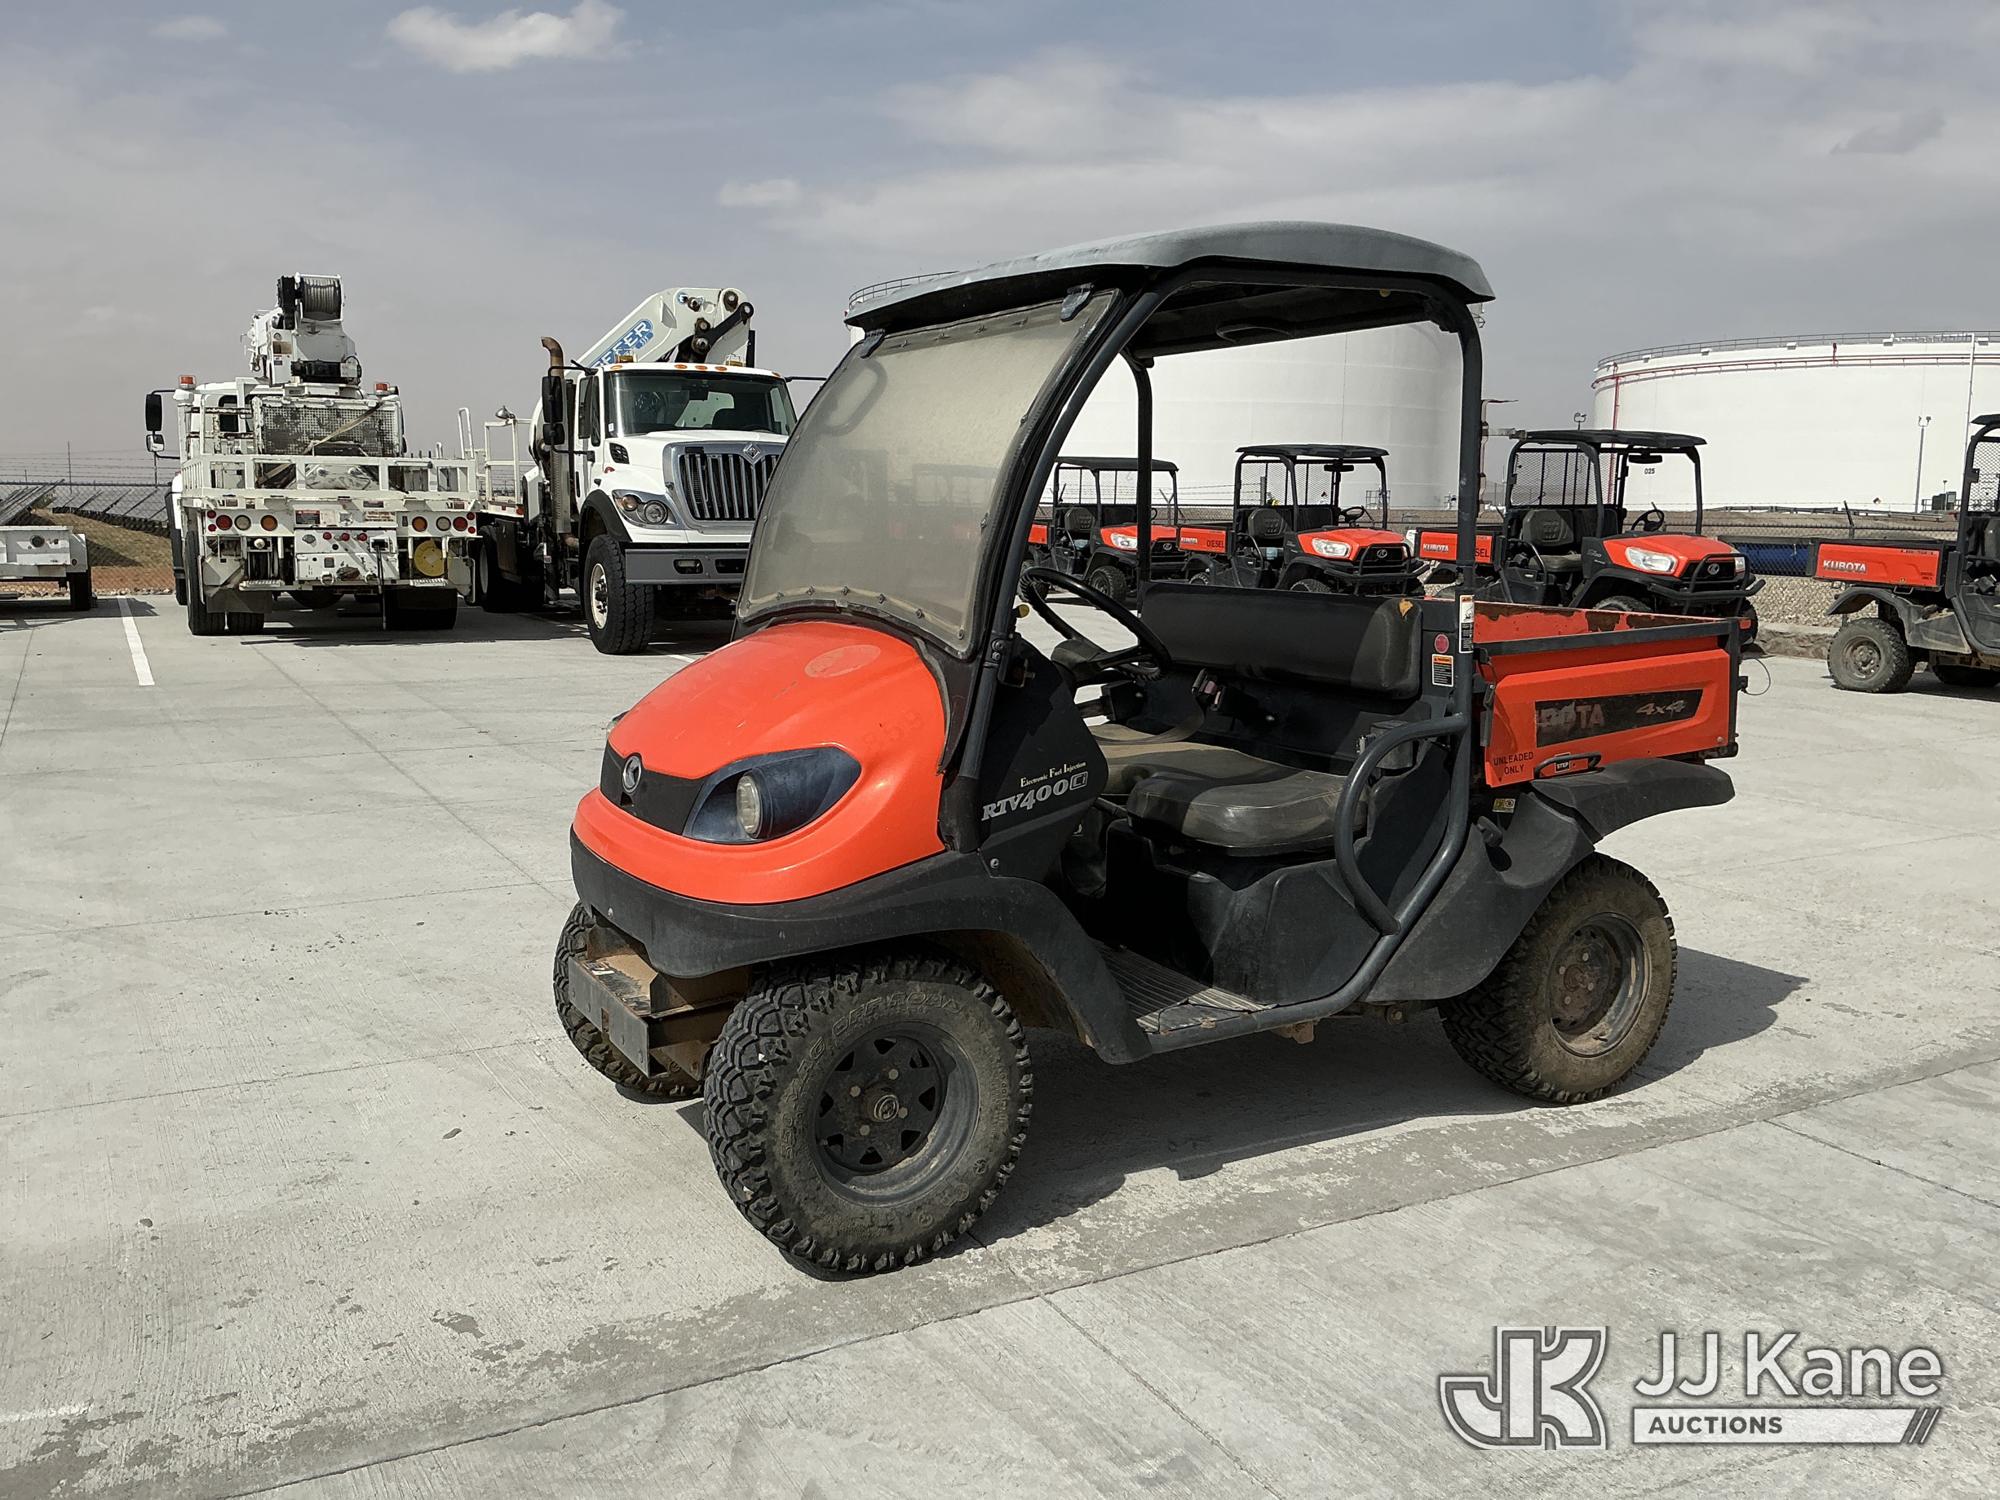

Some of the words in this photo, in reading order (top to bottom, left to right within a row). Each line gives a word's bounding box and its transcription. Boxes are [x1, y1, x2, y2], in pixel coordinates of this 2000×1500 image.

[1475, 547, 1490, 558] SEL
[1823, 560, 1867, 573] KUBOTA
[1493, 751, 1534, 766] UNLEADED
[1504, 764, 1525, 775] ONLY
[1556, 761, 1570, 769] STEP
[1020, 775, 1048, 788] Electronic
[1049, 767, 1062, 778] Fuel
[1063, 762, 1086, 773] Injection
